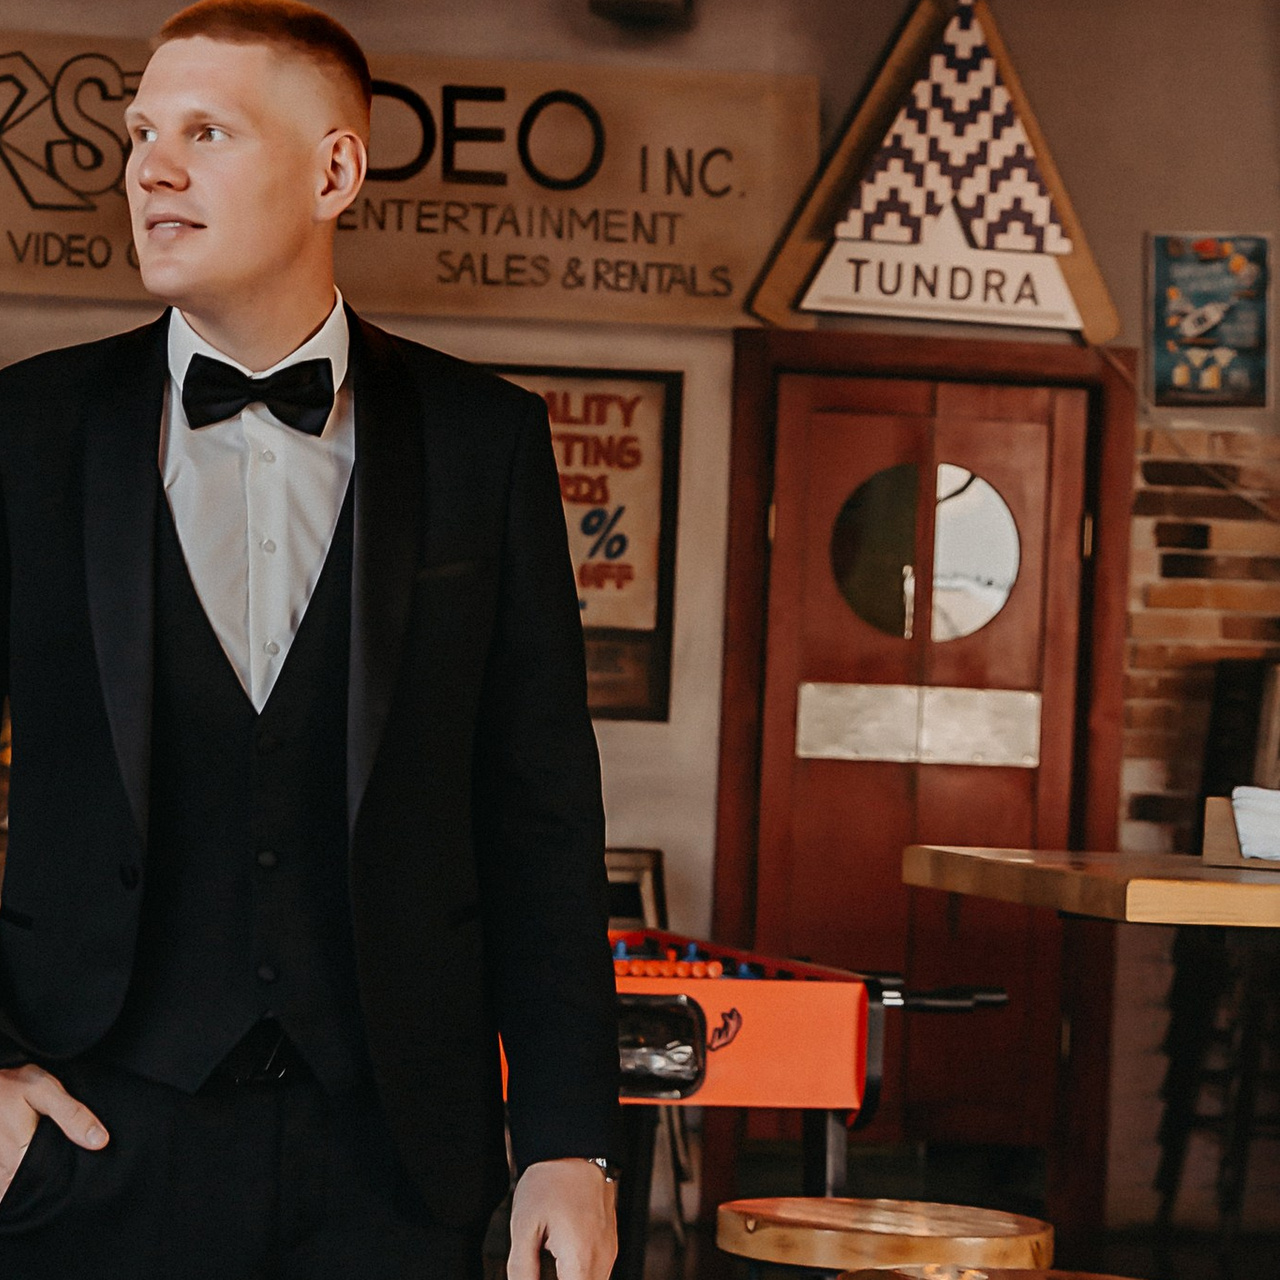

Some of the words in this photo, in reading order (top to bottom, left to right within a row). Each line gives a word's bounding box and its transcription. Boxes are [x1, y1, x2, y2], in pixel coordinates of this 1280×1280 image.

[365, 79, 606, 192] DEO
[336, 197, 685, 247] ENTERTAINMENT
[8, 230, 113, 270] VIDEO
[436, 250, 551, 290] SALES
[561, 256, 586, 290] &
[592, 257, 734, 299] RENTALS
[846, 256, 1041, 308] TUNDRA
